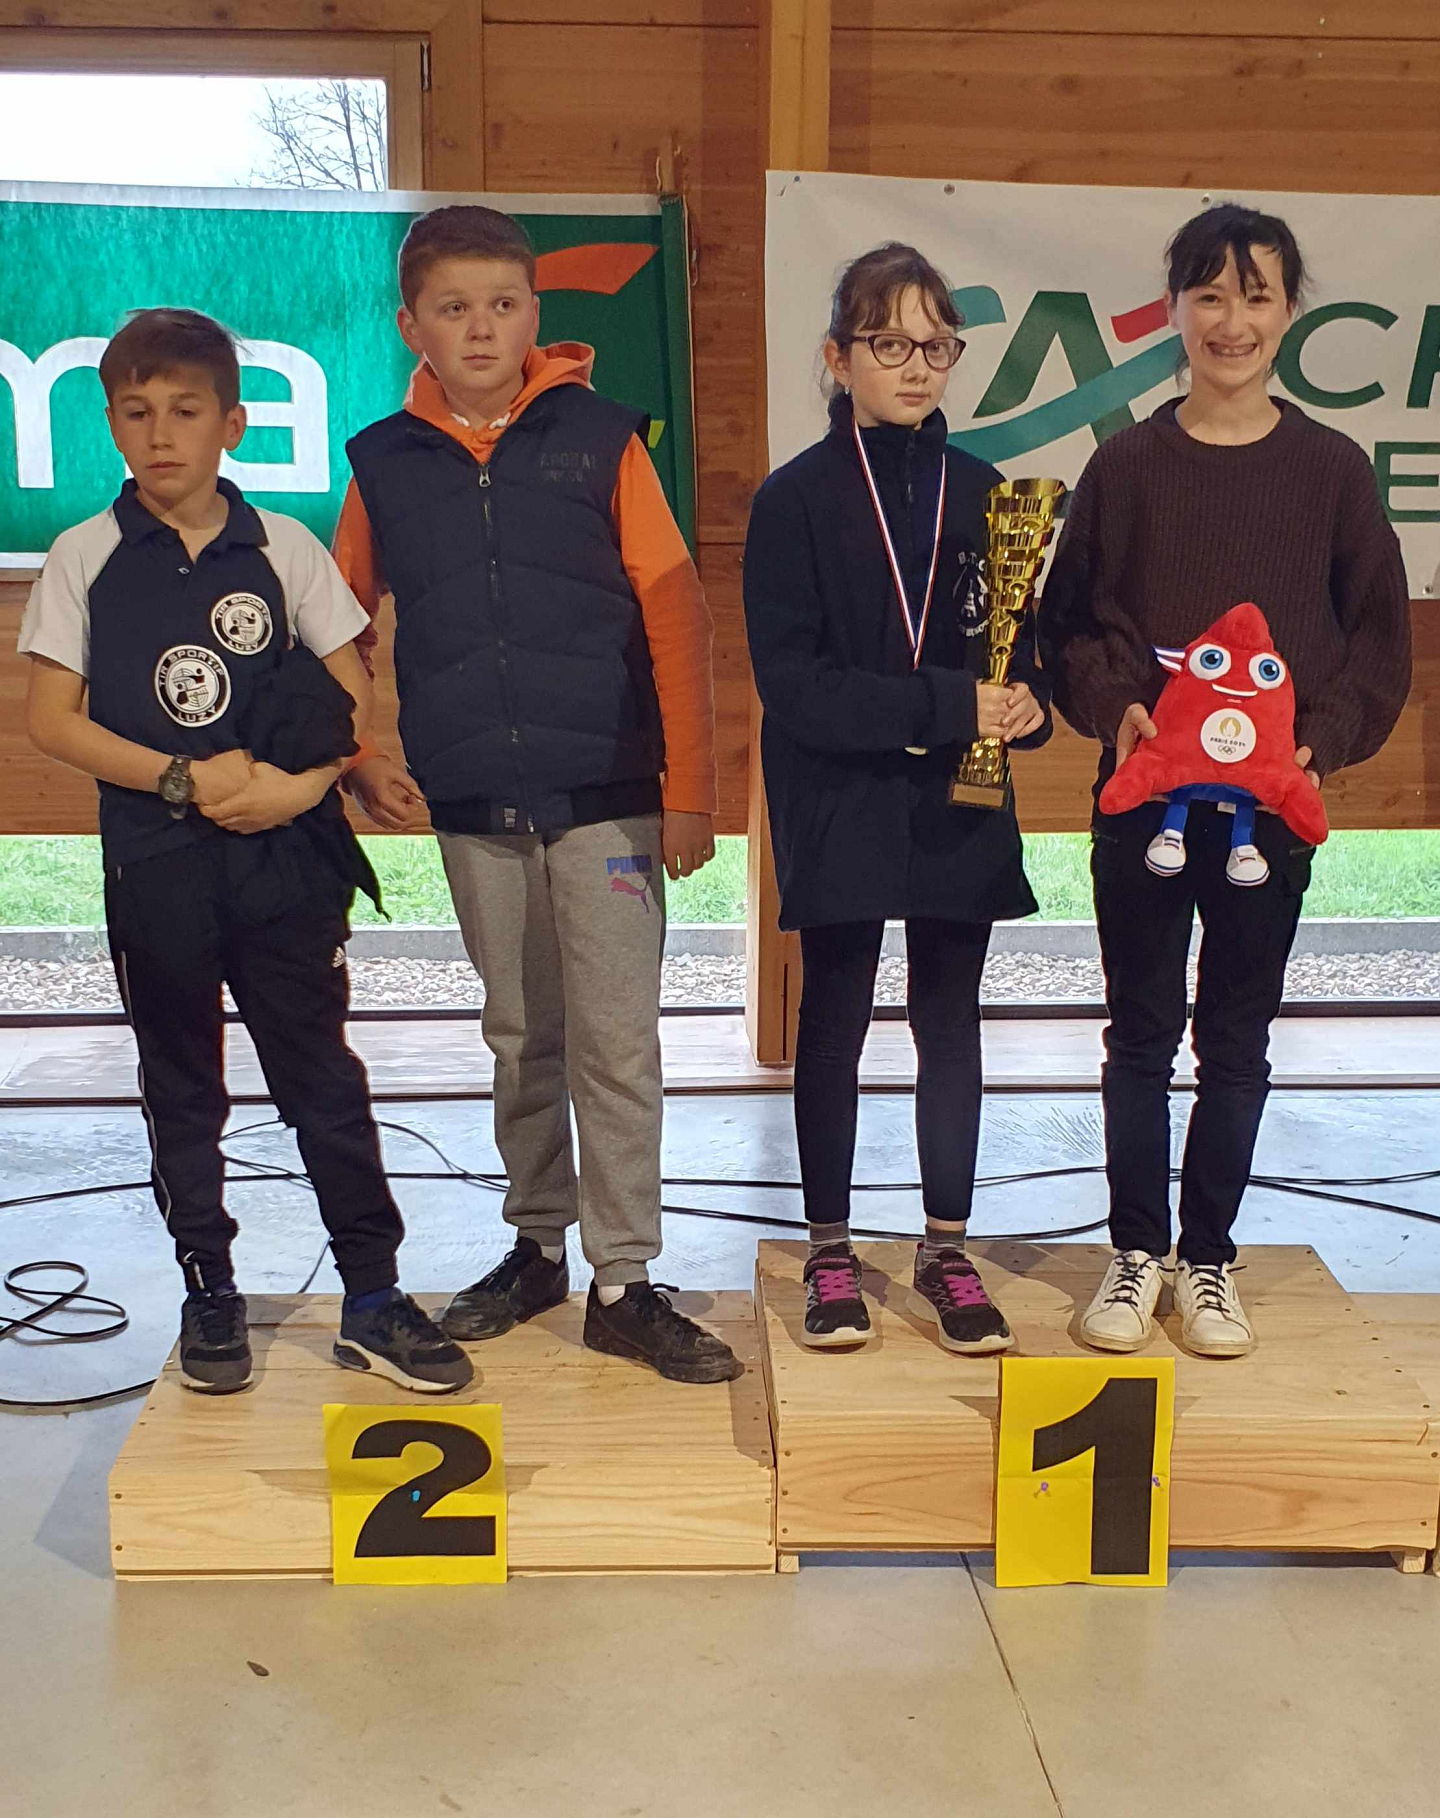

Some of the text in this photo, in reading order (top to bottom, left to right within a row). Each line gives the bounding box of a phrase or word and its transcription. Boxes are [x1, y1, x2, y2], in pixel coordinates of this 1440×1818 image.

[168, 649, 226, 676] SPORTIF
[177, 705, 216, 723] LUZY
[351, 1419, 497, 1558] 2
[1032, 1377, 1158, 1576] 1
